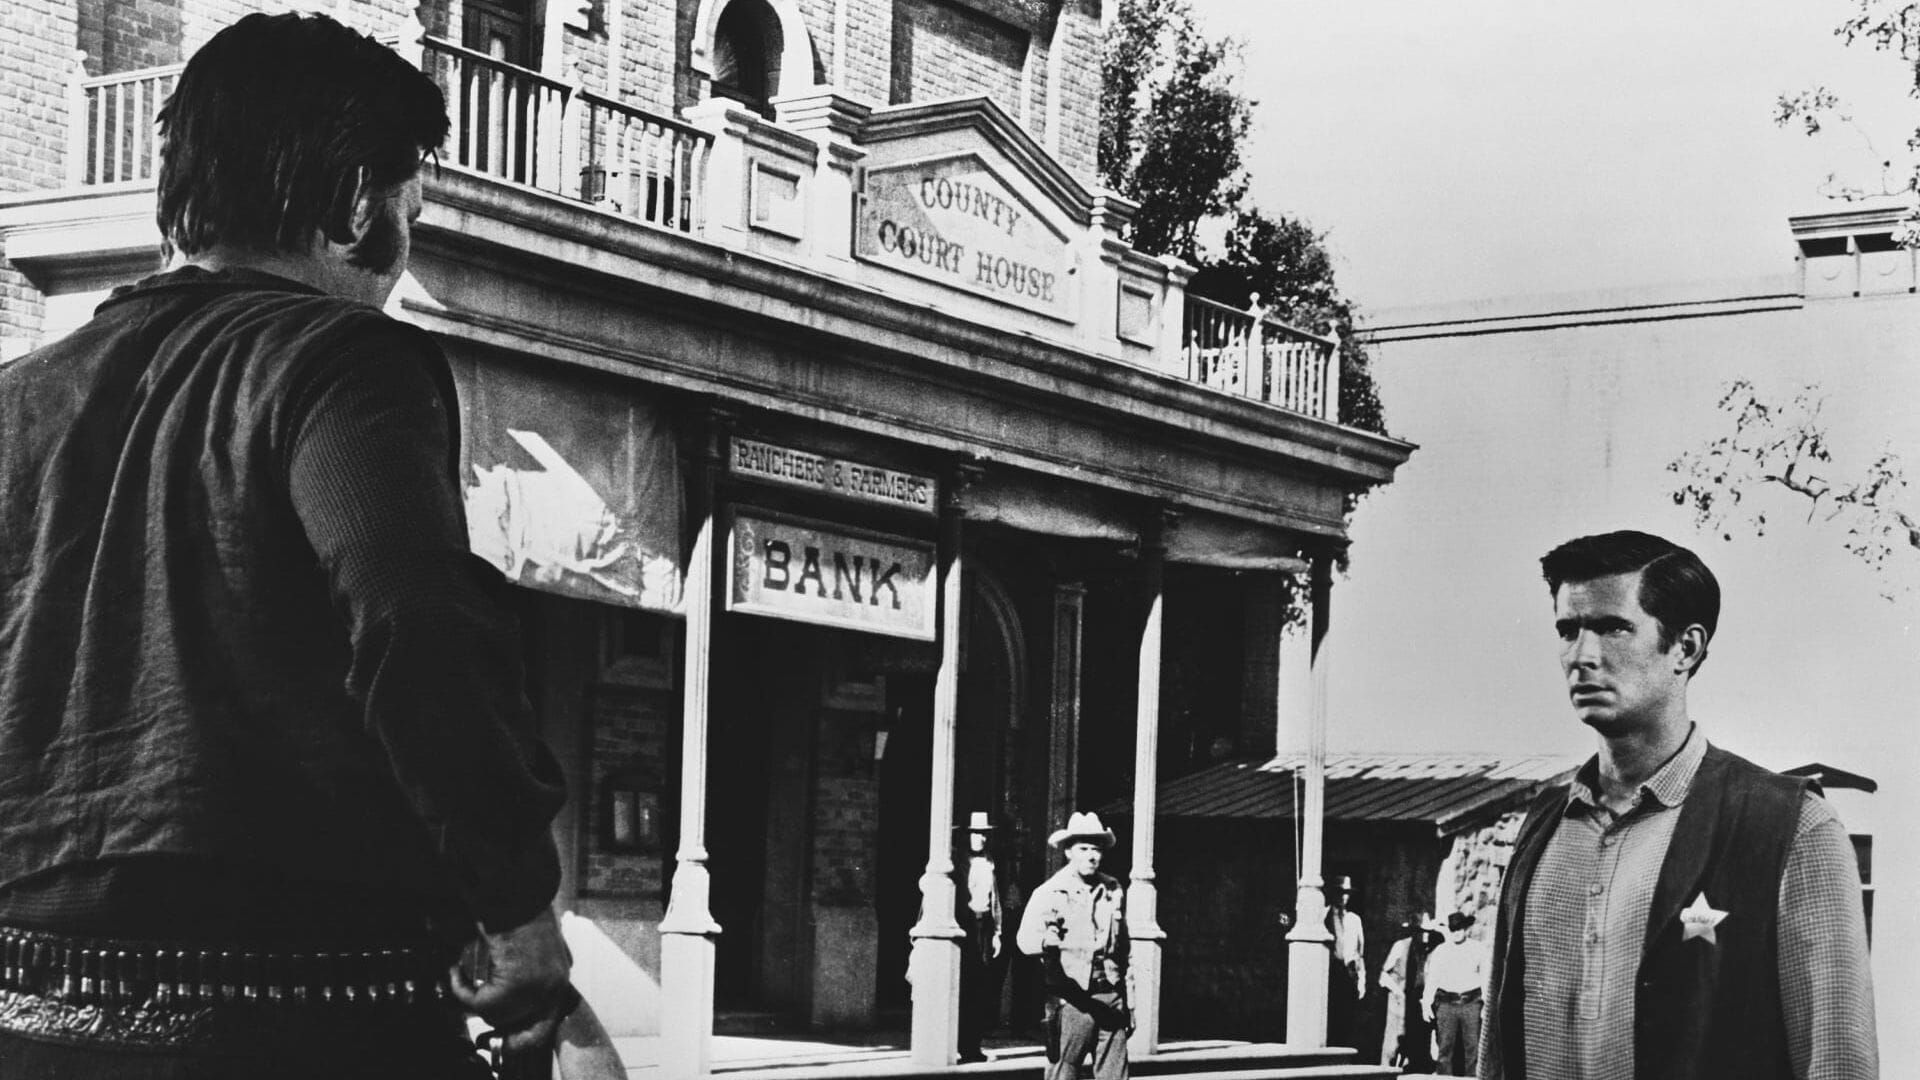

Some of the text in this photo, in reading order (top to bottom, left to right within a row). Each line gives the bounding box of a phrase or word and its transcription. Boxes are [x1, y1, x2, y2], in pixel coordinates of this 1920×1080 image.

[921, 178, 1021, 236] COUNTY
[878, 220, 1055, 302] COURT HOUSE
[738, 443, 927, 504] RANCHERS & FARMERS
[764, 539, 901, 610] BANK
